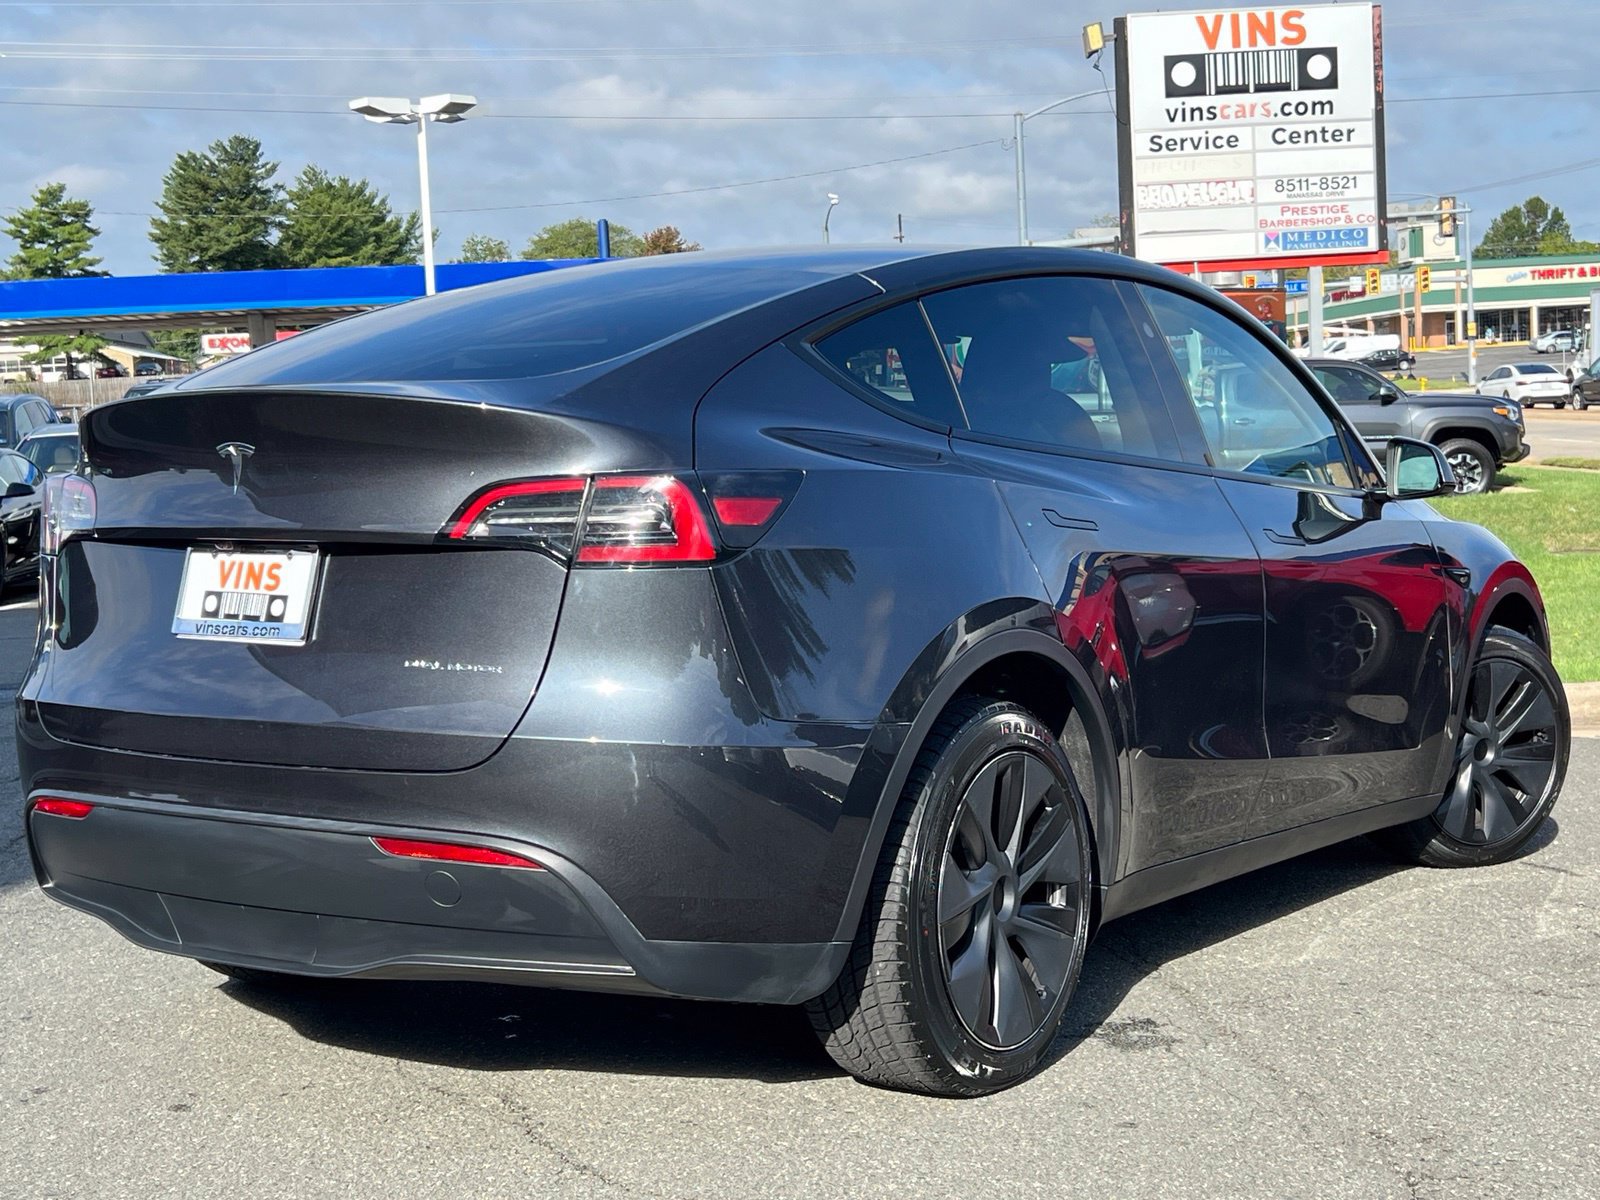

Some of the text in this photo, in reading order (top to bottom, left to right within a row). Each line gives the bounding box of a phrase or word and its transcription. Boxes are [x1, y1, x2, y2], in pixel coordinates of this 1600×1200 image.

[1195, 10, 1307, 50] VINS
[1165, 99, 1334, 123] vinscars.com
[1149, 126, 1355, 153] Service Center
[1275, 176, 1358, 193] 8511-8521
[1281, 204, 1349, 216] PRESTIGE
[1259, 216, 1342, 228] BARBERSHOP
[1344, 215, 1354, 224] &
[1287, 229, 1364, 242] MEDICO
[1287, 240, 1362, 250] FAMILY CLINIC
[1530, 268, 1575, 280] THRIFT
[1577, 266, 1587, 277] &
[1590, 265, 1600, 277] B
[219, 559, 282, 592] VINS
[195, 620, 281, 637] vinscars.com
